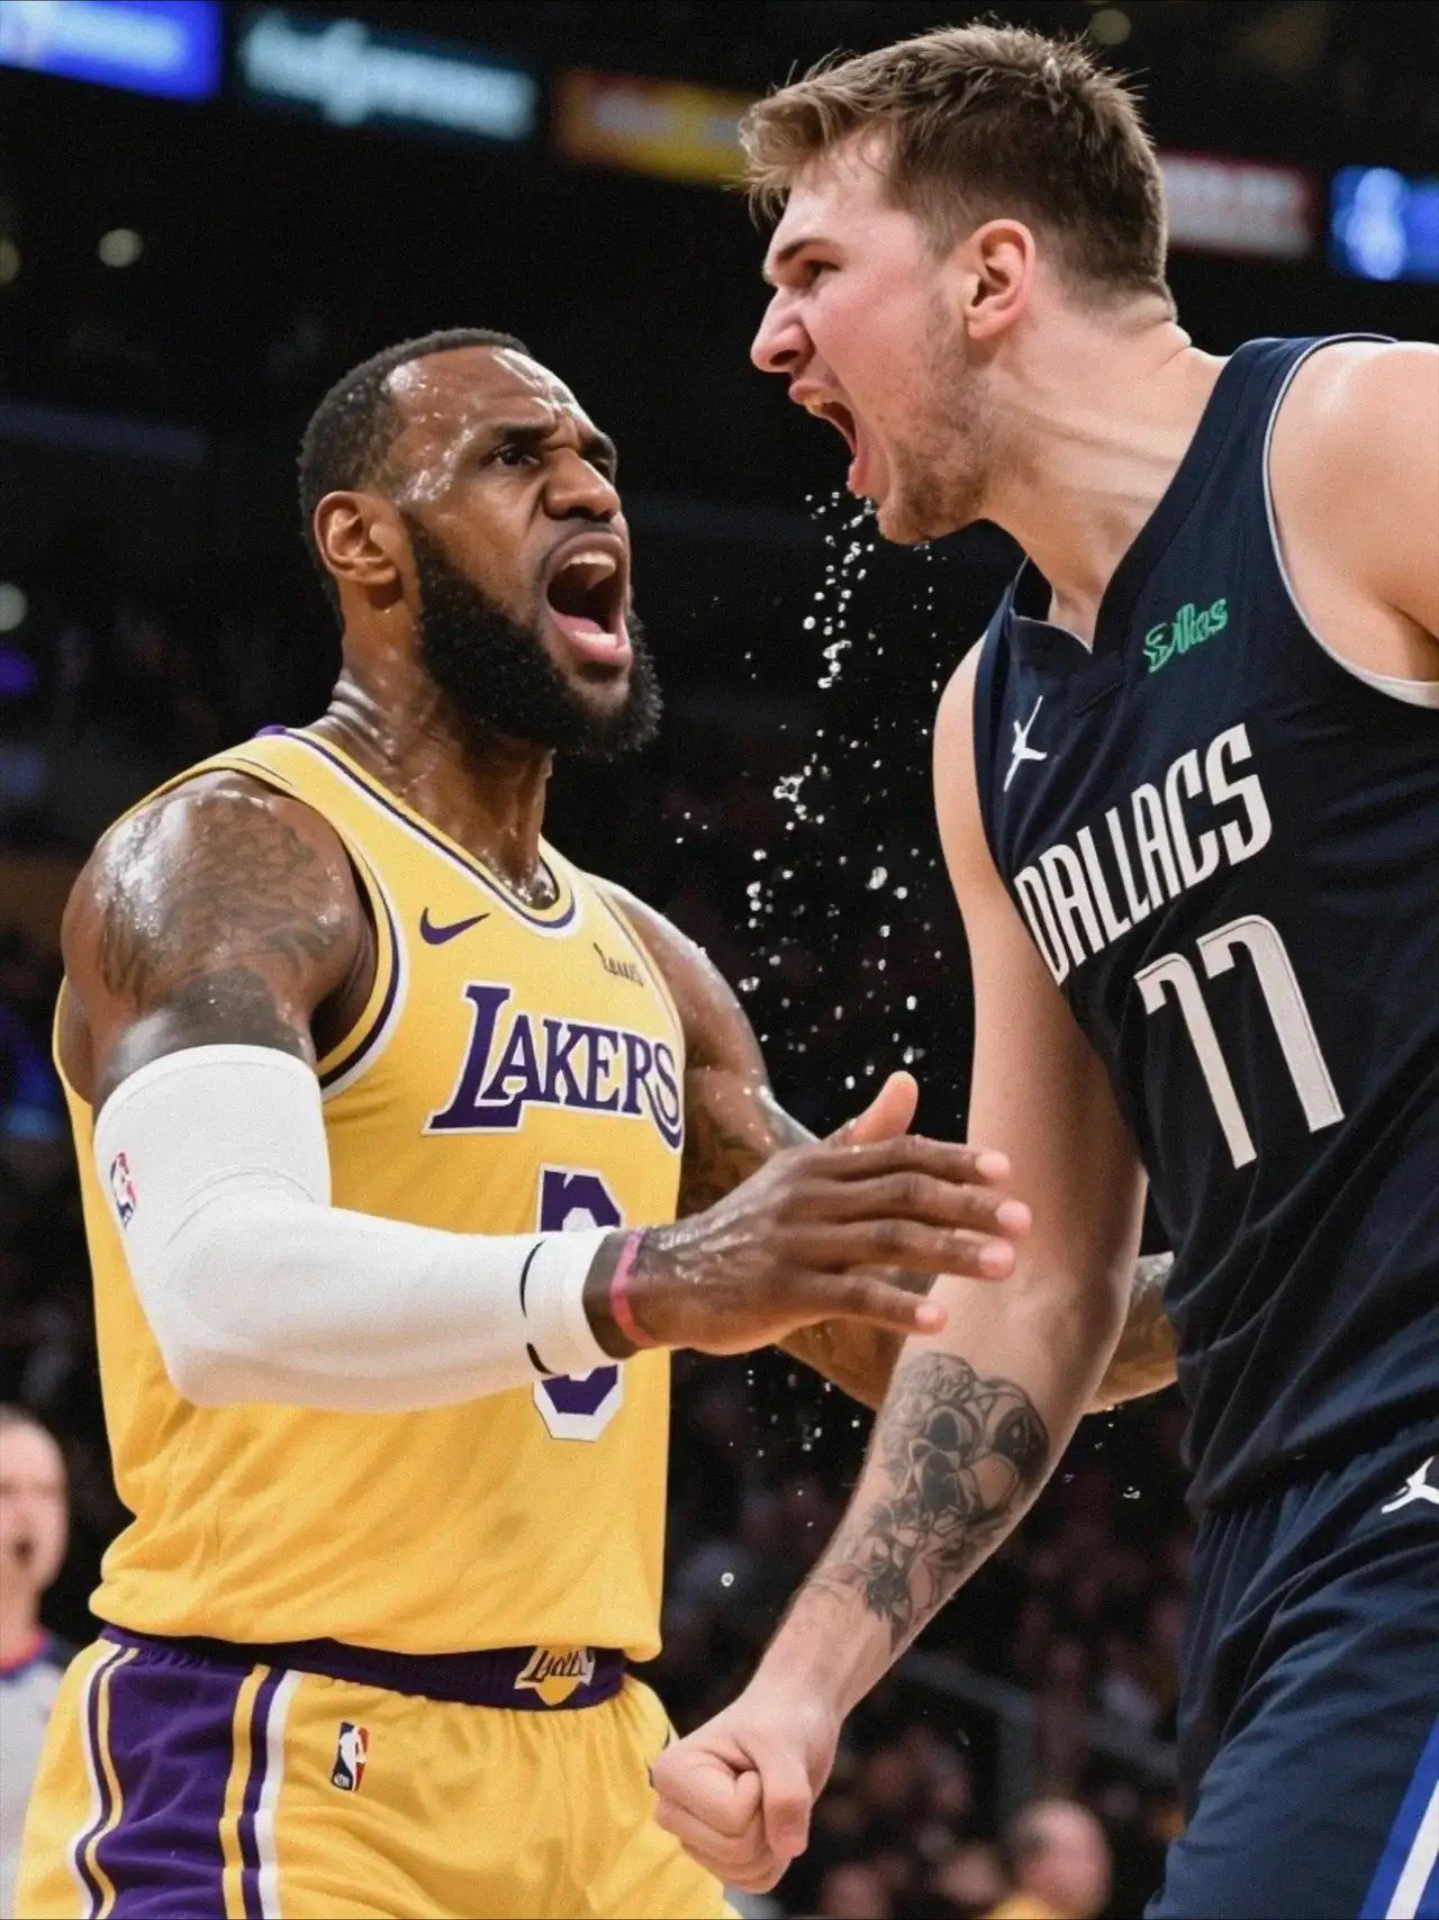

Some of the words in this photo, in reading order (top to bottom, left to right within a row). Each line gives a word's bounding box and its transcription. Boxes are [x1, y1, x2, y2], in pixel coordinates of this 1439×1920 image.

[1013, 723, 1273, 987] DALLACS
[424, 982, 684, 1151] LAKERS
[1134, 913, 1346, 1170] 77
